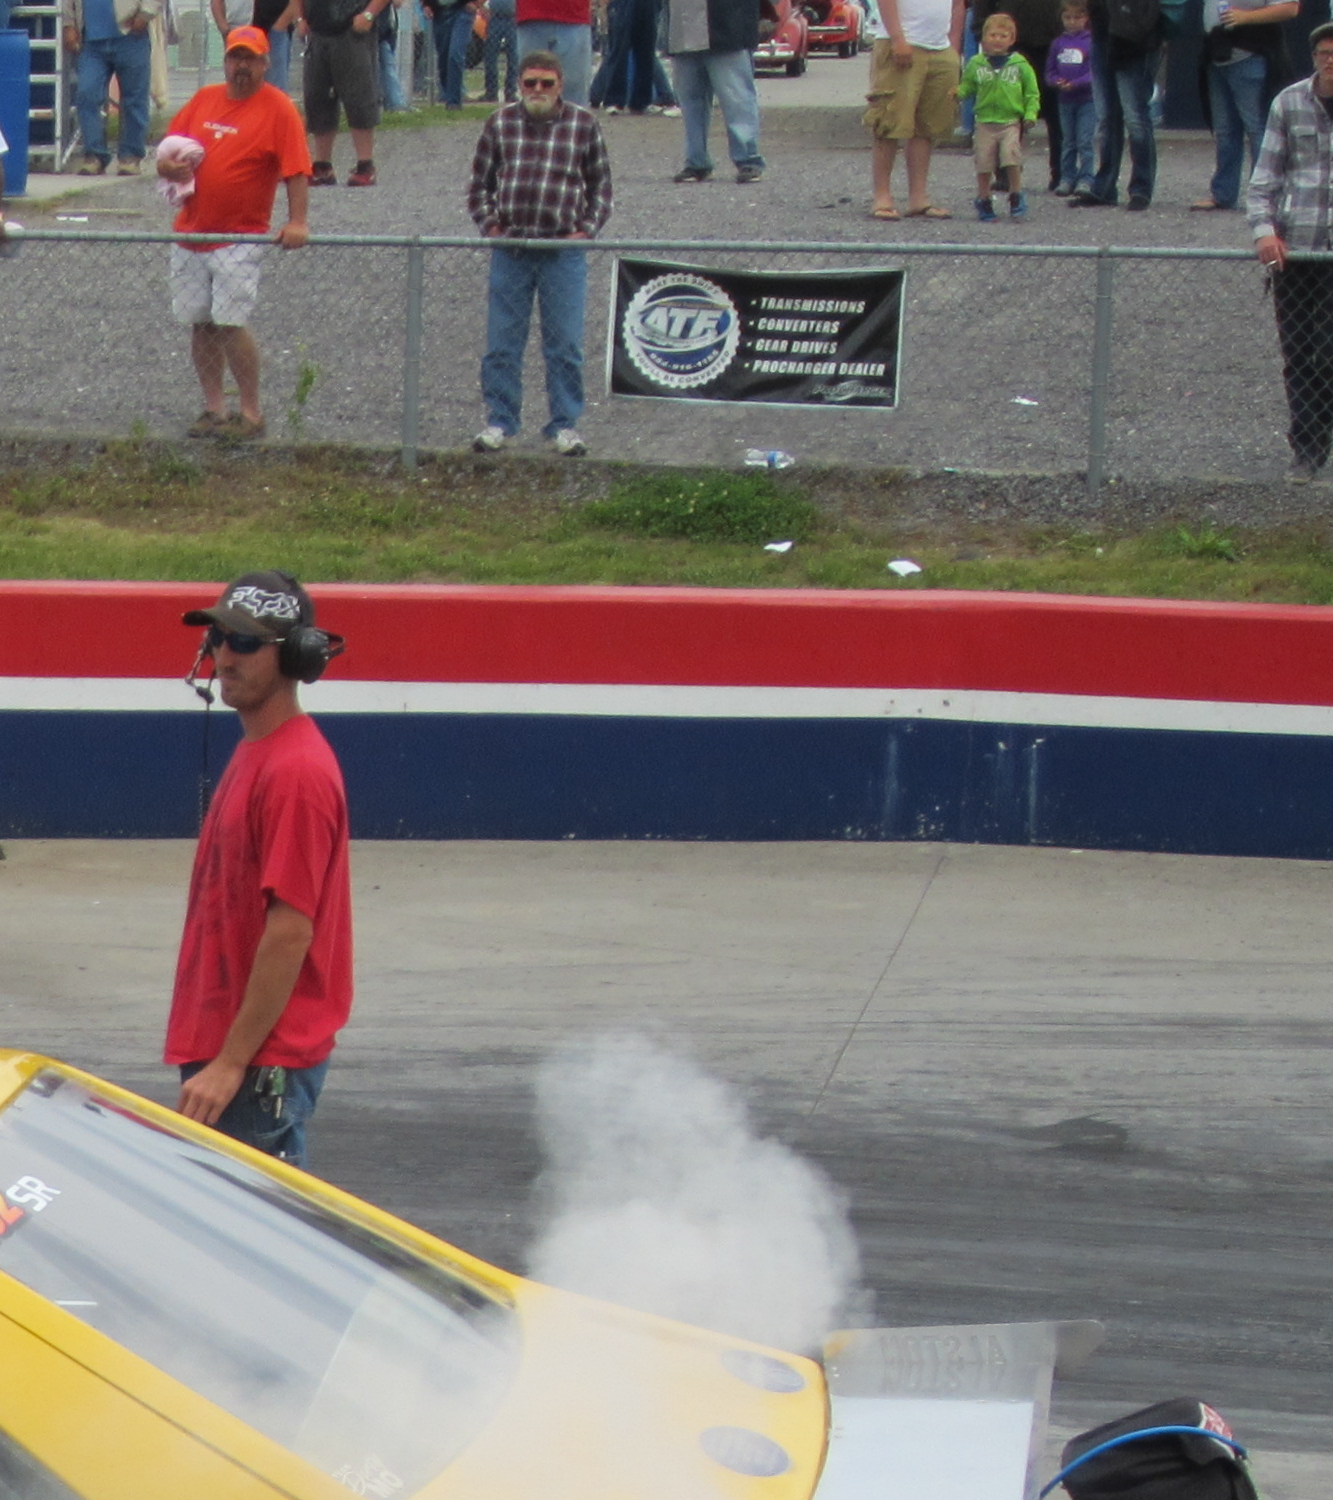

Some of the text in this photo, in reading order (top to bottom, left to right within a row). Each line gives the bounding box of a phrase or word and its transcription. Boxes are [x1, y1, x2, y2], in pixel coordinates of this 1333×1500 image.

[760, 296, 866, 314] TRANSMISSIONS
[757, 317, 841, 333] CONVERTERS
[754, 340, 838, 354] GEAR DRIVES
[751, 361, 886, 376] PROCHARGER DEALER
[5, 1175, 62, 1212] SR
